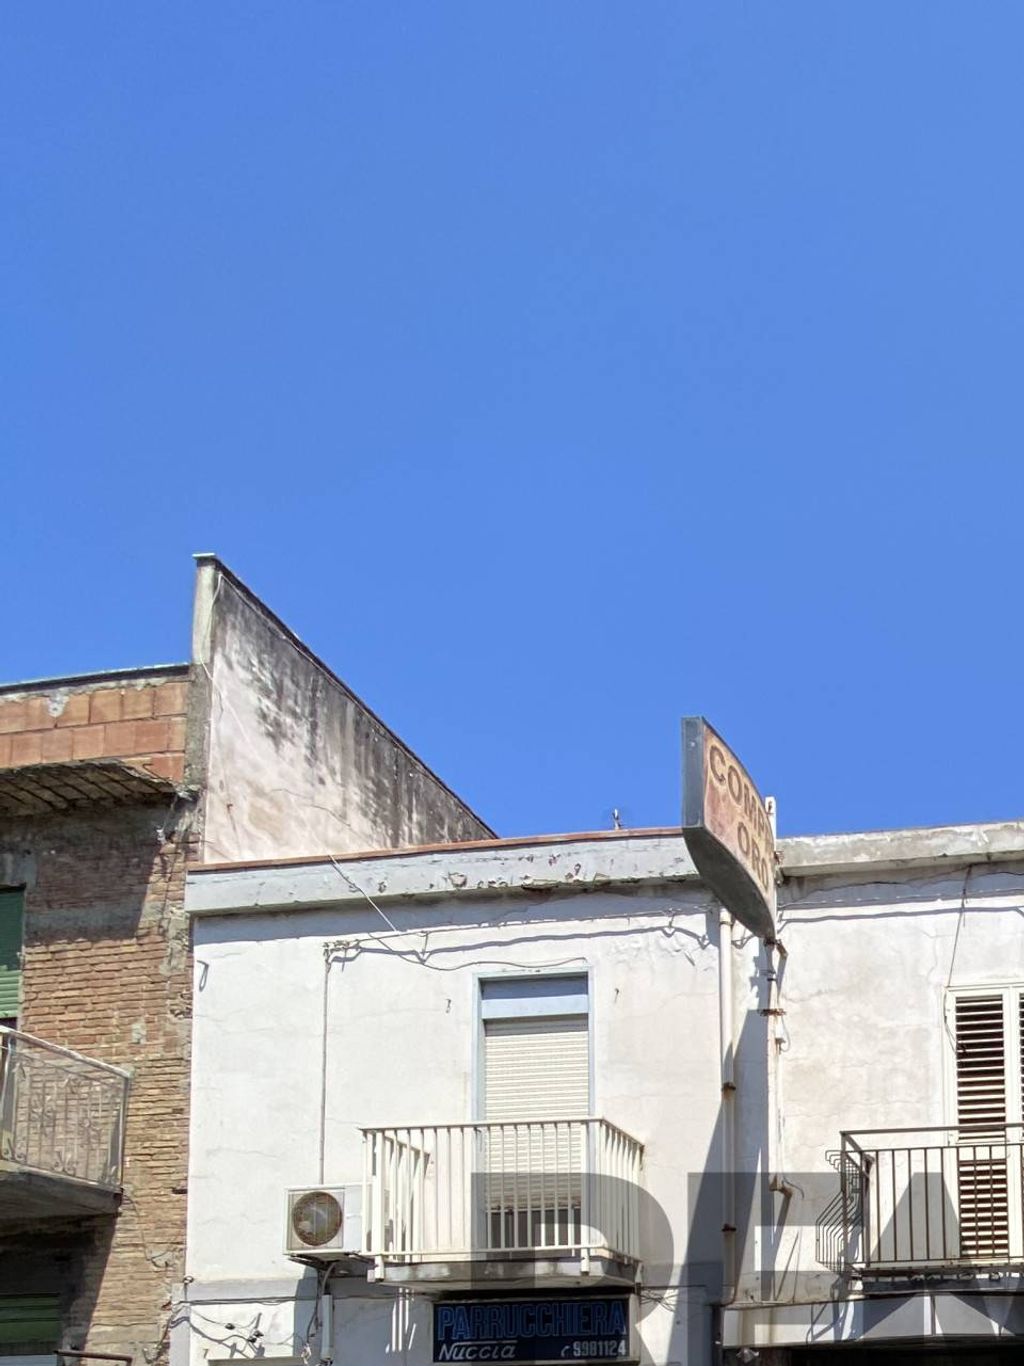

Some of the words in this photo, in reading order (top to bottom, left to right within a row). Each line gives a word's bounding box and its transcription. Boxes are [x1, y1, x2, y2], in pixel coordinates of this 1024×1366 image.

[738, 821, 769, 891] ORO
[439, 1302, 627, 1340] PARRUCCHIERA
[439, 1341, 517, 1360] Nuccia
[573, 1340, 626, 1357] 9981124
